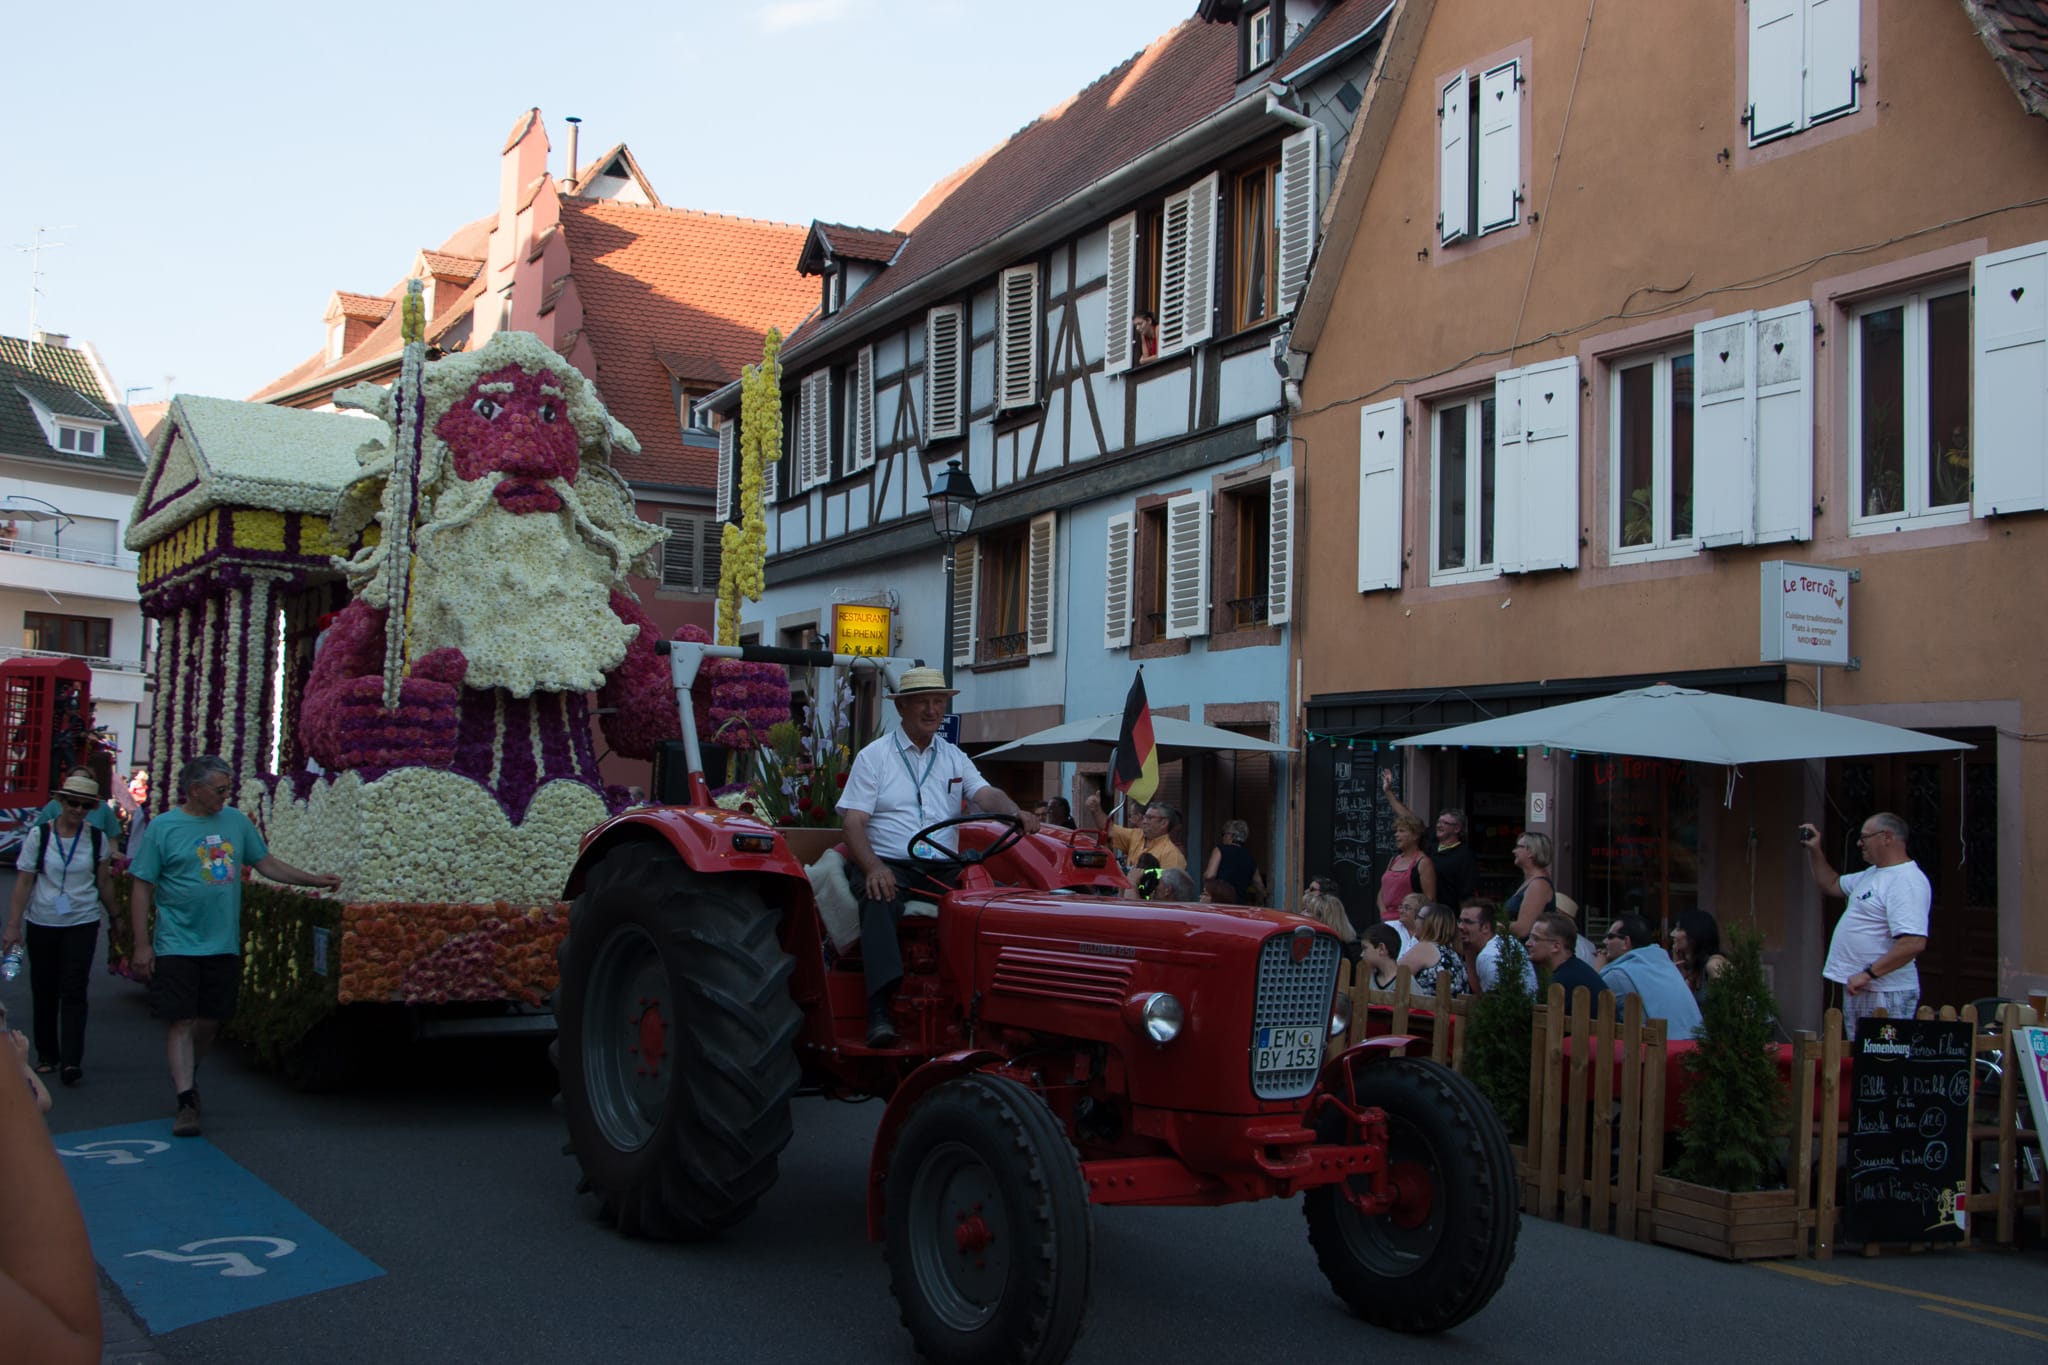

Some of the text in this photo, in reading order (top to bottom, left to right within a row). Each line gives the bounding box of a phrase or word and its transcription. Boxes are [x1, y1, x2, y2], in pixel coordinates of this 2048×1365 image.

[1783, 577, 1837, 598] Le Terroir
[840, 612, 887, 623] RESTAURANT
[842, 629, 884, 640] LE PHENIX
[1593, 762, 1616, 785] Le
[1274, 1030, 1296, 1048] EM
[1863, 1038, 1910, 1058] Kronenbourg
[1260, 1049, 1316, 1069] BY 153
